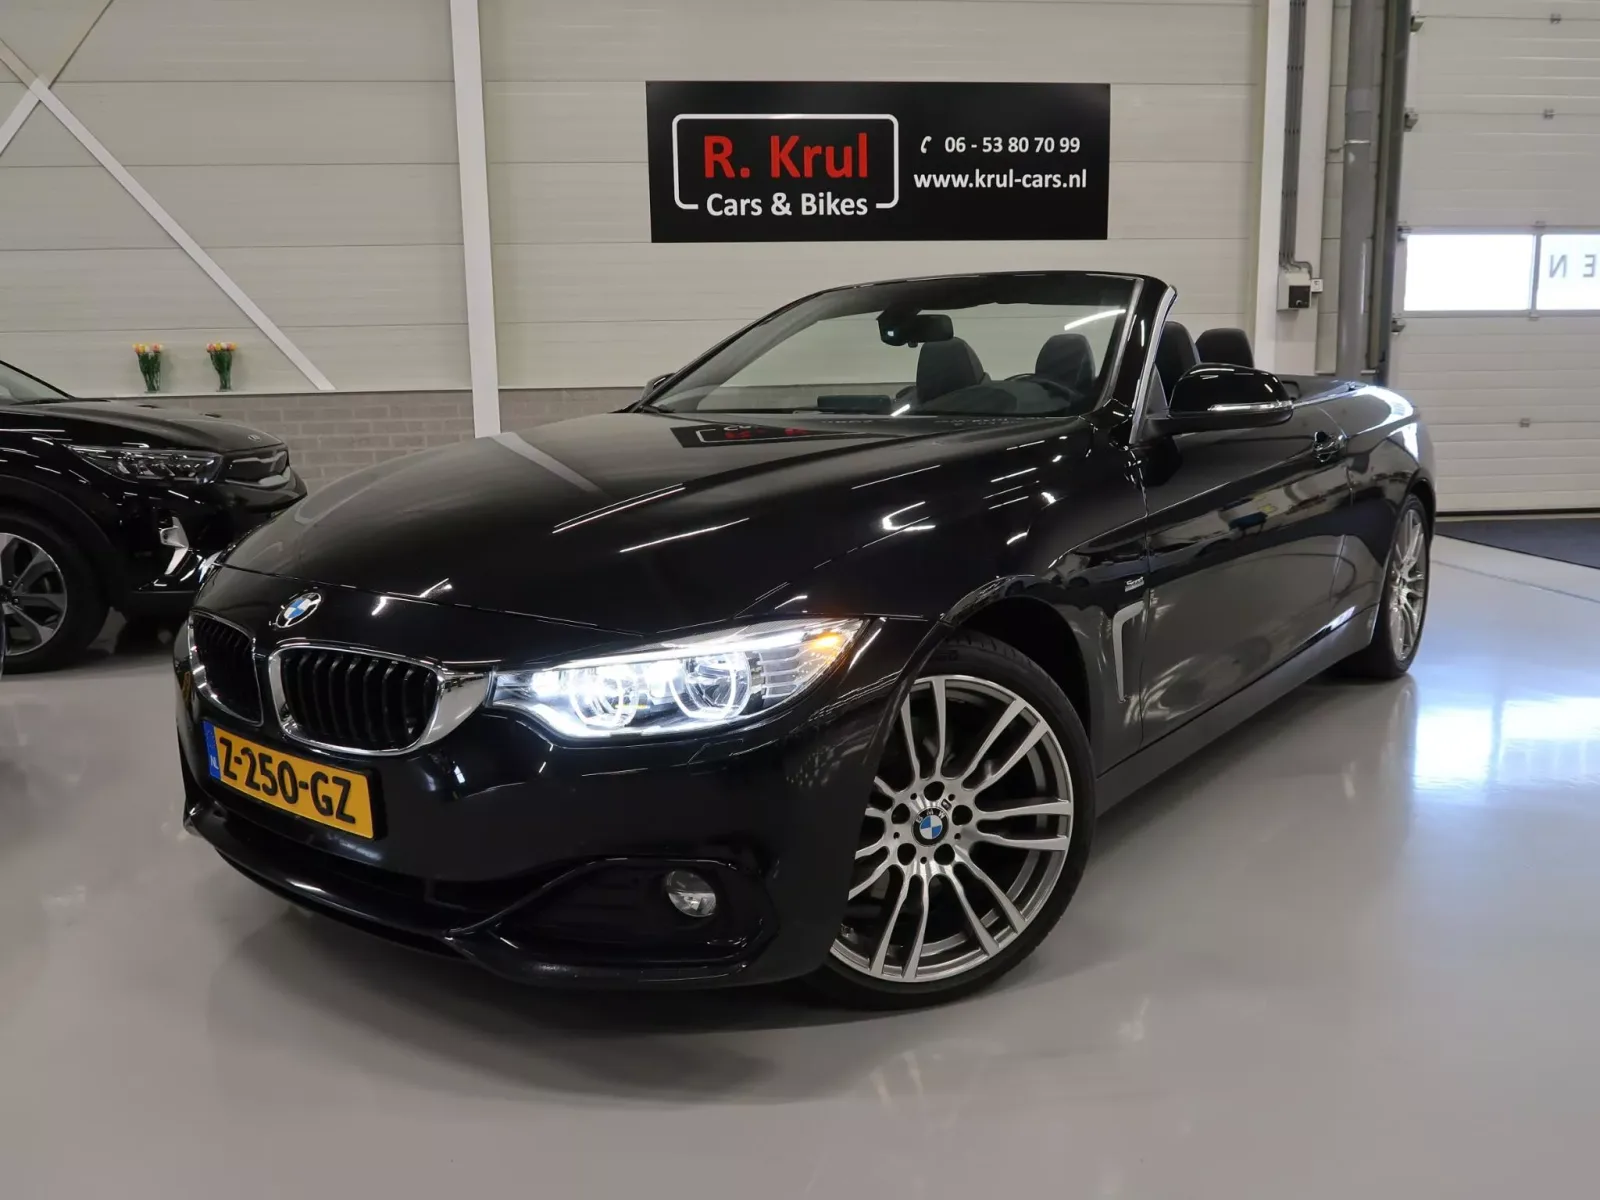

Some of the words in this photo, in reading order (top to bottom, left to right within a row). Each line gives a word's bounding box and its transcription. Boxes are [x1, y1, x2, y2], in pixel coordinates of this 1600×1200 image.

[704, 135, 751, 179] R.
[770, 132, 868, 179] Krul
[944, 136, 966, 153] 06
[982, 136, 1003, 153] 53
[1007, 136, 1030, 153] 80
[1034, 136, 1055, 153] 70
[1059, 136, 1081, 153] 99
[913, 168, 1087, 188] www.krul-cars.nl
[706, 192, 763, 217] Cars
[770, 192, 793, 216] &
[801, 191, 868, 216] Bikes
[218, 736, 356, 825] Z-250-GZ
